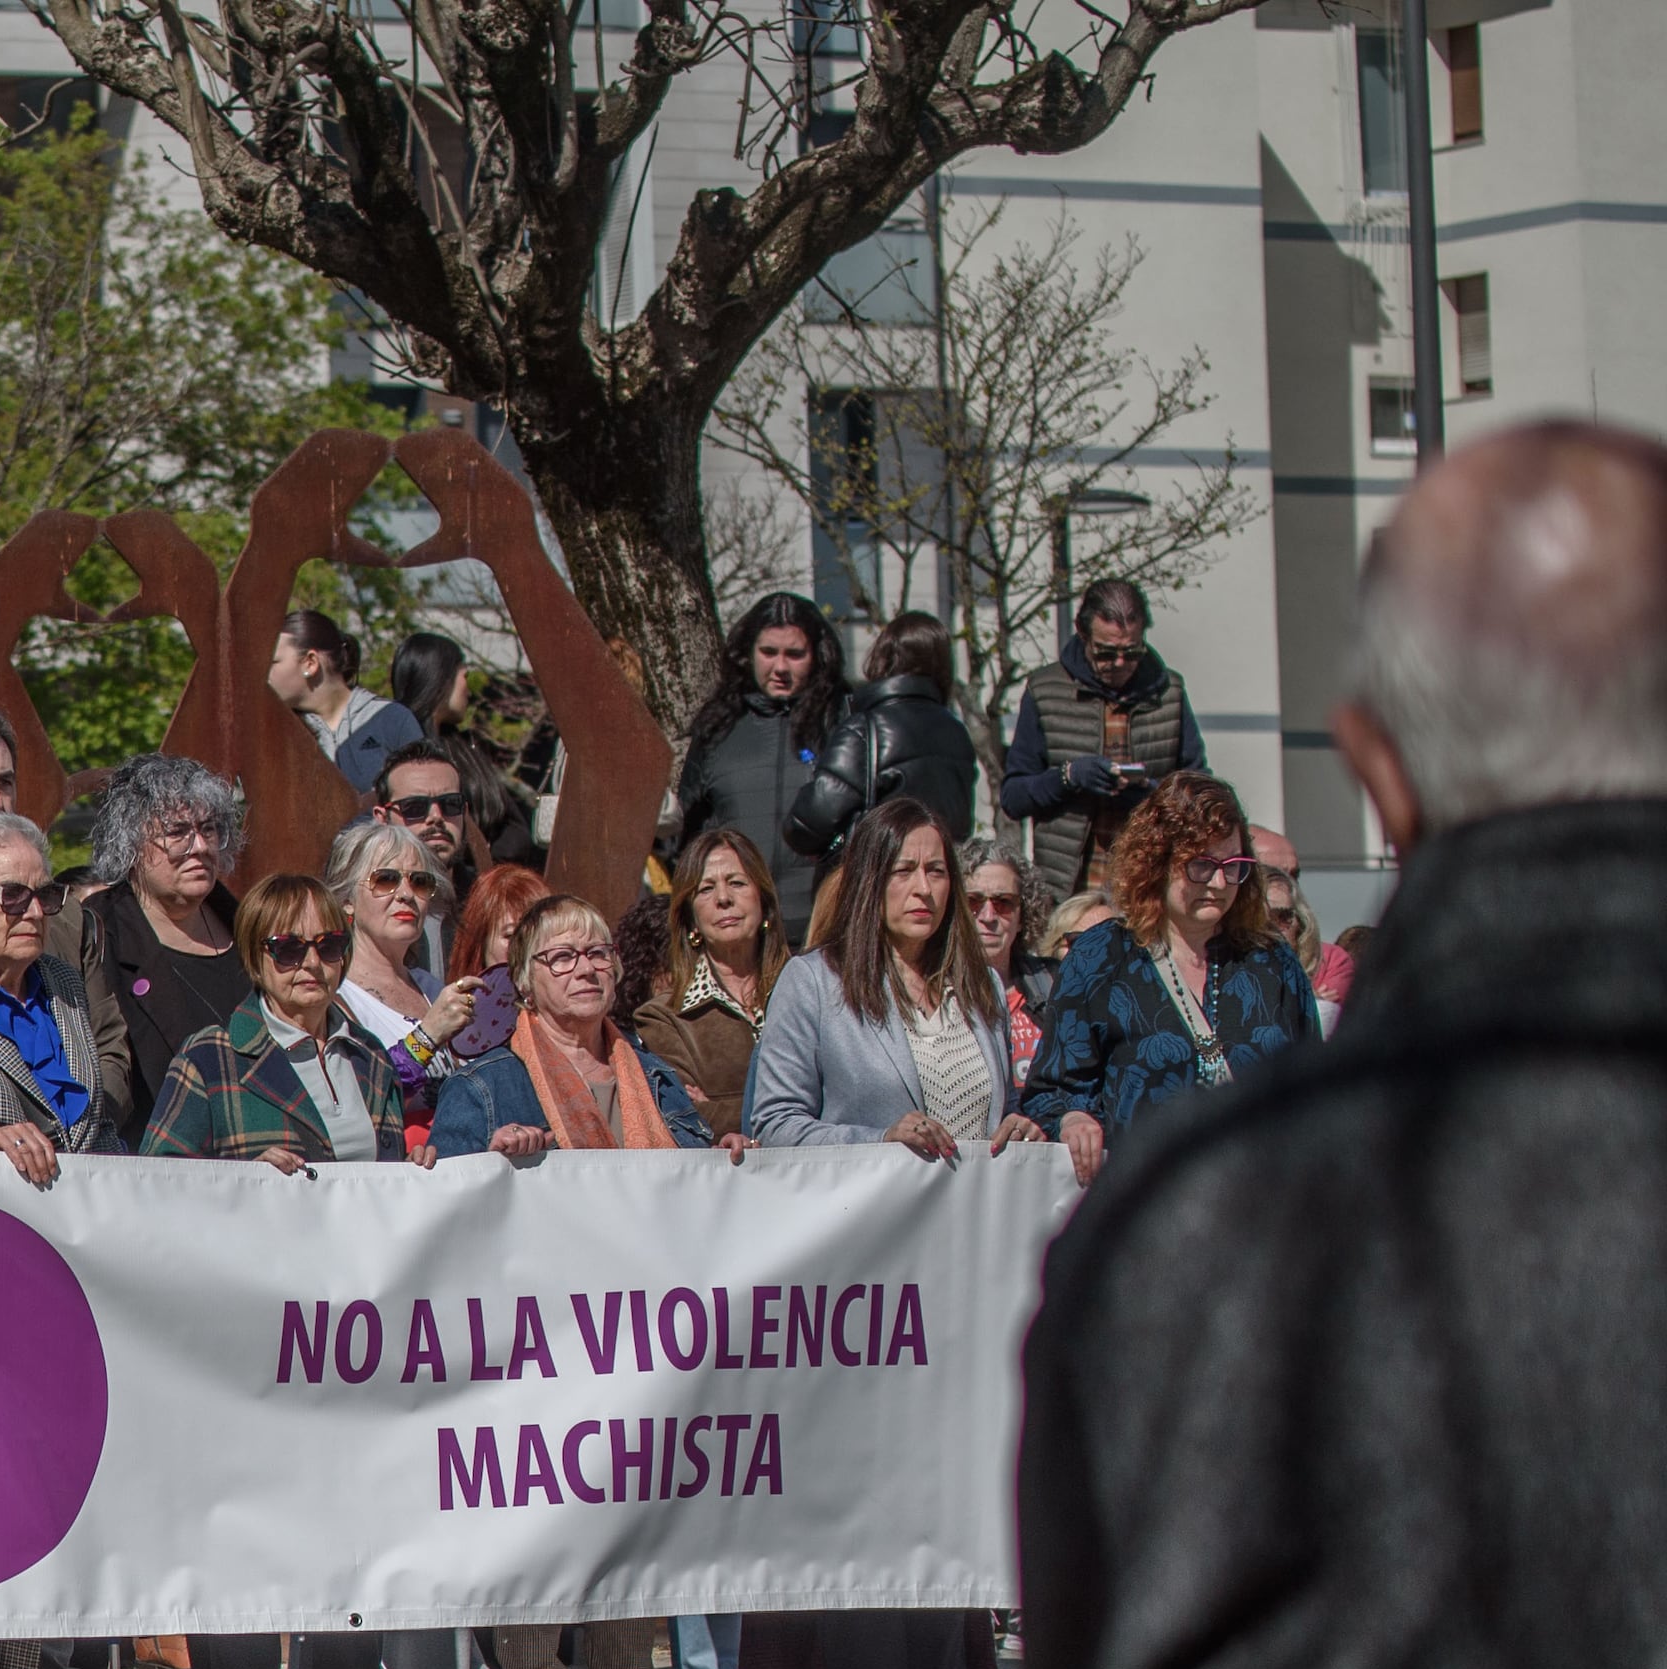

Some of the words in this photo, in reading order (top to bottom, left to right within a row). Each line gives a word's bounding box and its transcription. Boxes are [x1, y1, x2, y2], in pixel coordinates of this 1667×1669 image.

[276, 1299, 383, 1384] NO
[400, 1299, 447, 1383] A
[467, 1296, 558, 1381] LA
[569, 1283, 929, 1376] VIOLENCIA
[437, 1413, 783, 1511] MACHISTA
